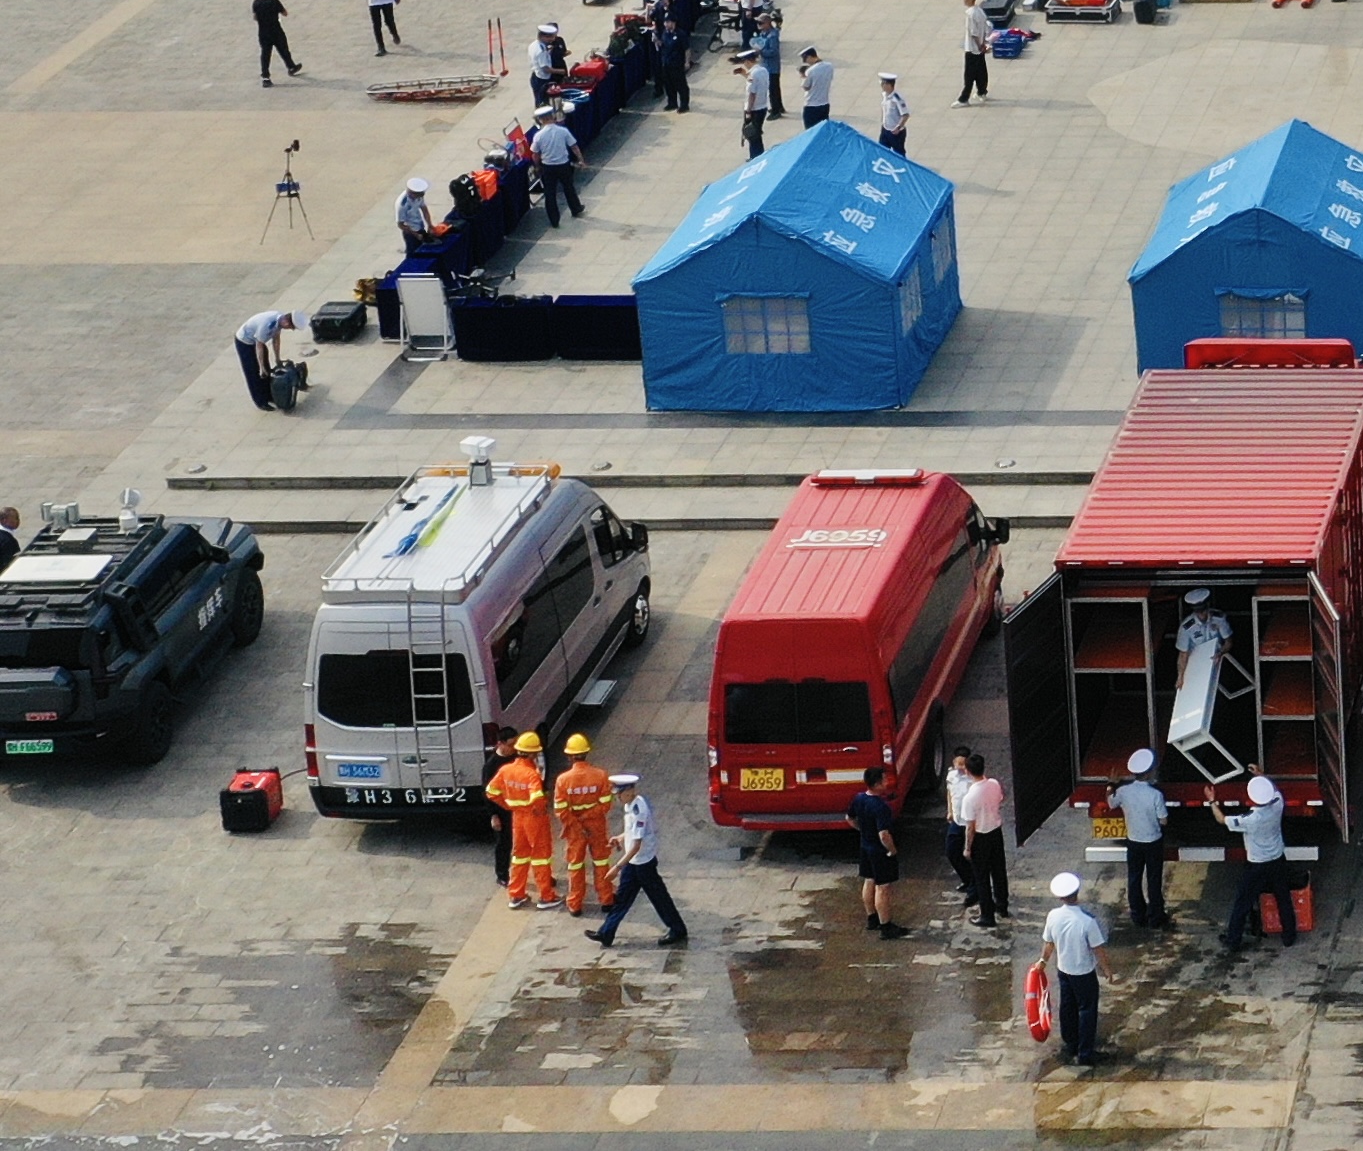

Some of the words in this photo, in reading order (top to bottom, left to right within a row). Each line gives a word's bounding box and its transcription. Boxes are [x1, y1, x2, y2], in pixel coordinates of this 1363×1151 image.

[790, 529, 887, 543] J6959
[742, 777, 782, 790] J6959
[1093, 824, 1126, 838] P607
